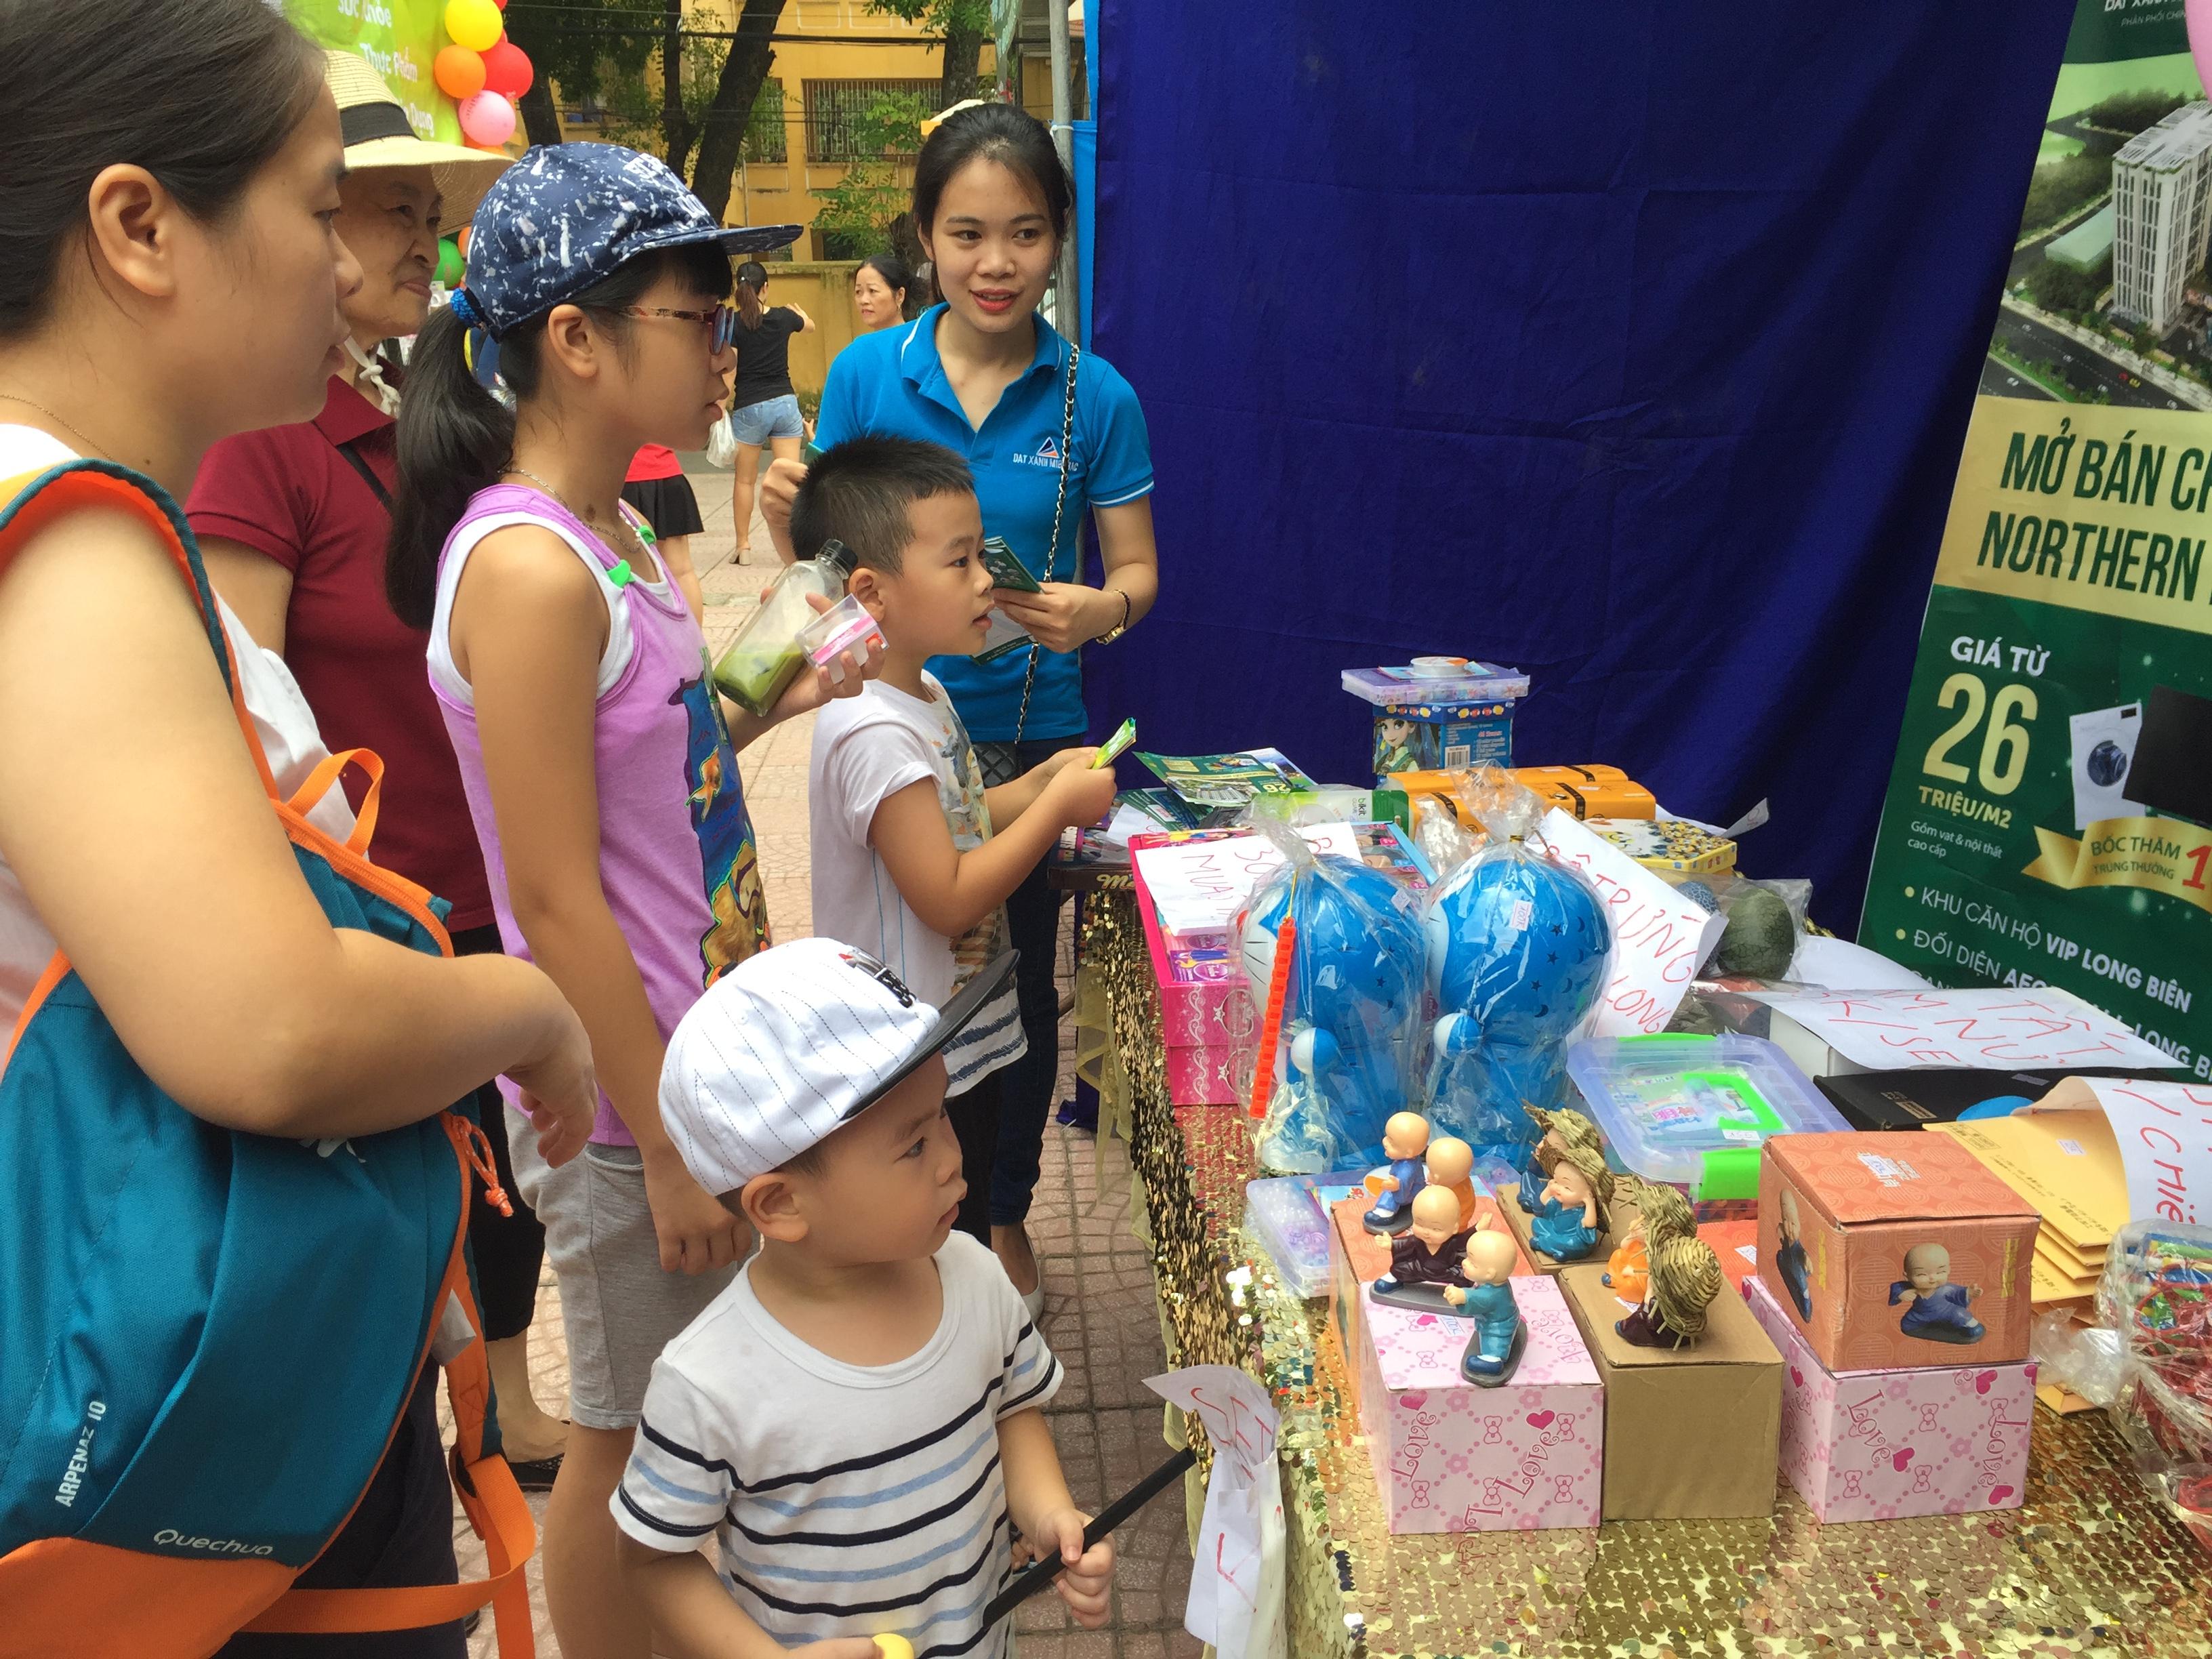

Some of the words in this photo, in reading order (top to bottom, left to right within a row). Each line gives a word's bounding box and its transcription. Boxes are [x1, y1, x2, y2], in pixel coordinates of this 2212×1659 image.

[2001, 416, 2076, 495] MỞ
[2074, 430, 2167, 507] BÁN
[1977, 510, 2207, 602] NORTHERN
[1950, 636, 2003, 669] GIÁ
[2010, 644, 2051, 677] TỪ
[1923, 672, 2039, 796] 26
[1919, 785, 2013, 830] TRIỆU/M2
[1908, 838, 1927, 851] cao
[2091, 834, 2127, 857] BỐC
[1913, 929, 1953, 958] ĐỐI
[1956, 945, 2002, 980] DIỆN
[1921, 887, 1963, 915] KHU
[1965, 901, 2009, 934] CĂN
[2011, 920, 2042, 950] HỘ
[2046, 933, 2079, 961] VIP
[2082, 949, 2142, 989] LONG
[2146, 975, 2192, 1014] BIÊN
[1390, 1411, 1437, 1482] Love
[1847, 1389, 1892, 1464] Love
[1977, 1416, 2029, 1488] Love
[54, 1425, 95, 1507] ARPENAZ
[1492, 1431, 1561, 1500] Love
[153, 1529, 273, 1556] Quechua
